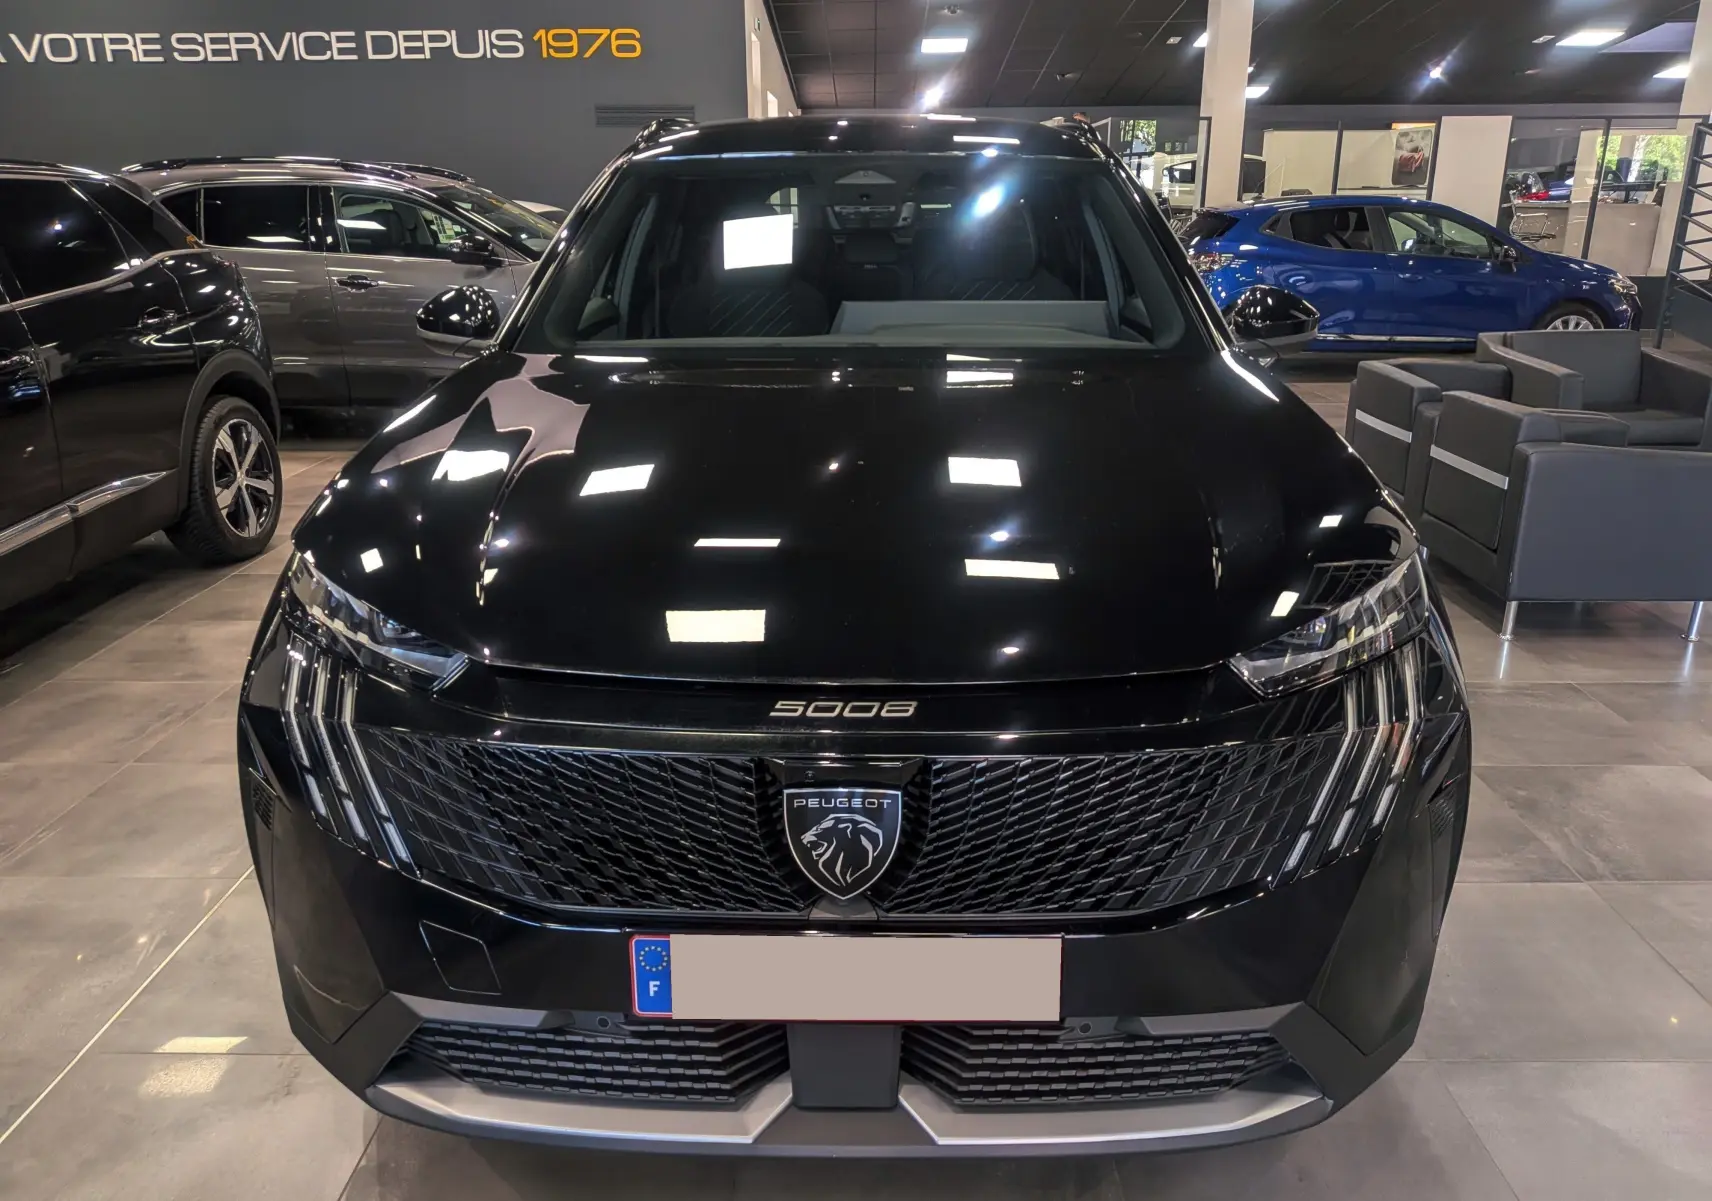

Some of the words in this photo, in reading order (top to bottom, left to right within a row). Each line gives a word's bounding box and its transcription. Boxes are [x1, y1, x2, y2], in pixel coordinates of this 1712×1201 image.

[8, 33, 164, 62] VOTRE
[171, 31, 358, 61] SERVICE
[366, 29, 524, 59] DEPUIS
[532, 28, 641, 58] 1976
[769, 701, 918, 717] 5008
[793, 798, 892, 809] PEUGEOT
[648, 980, 661, 997] F
